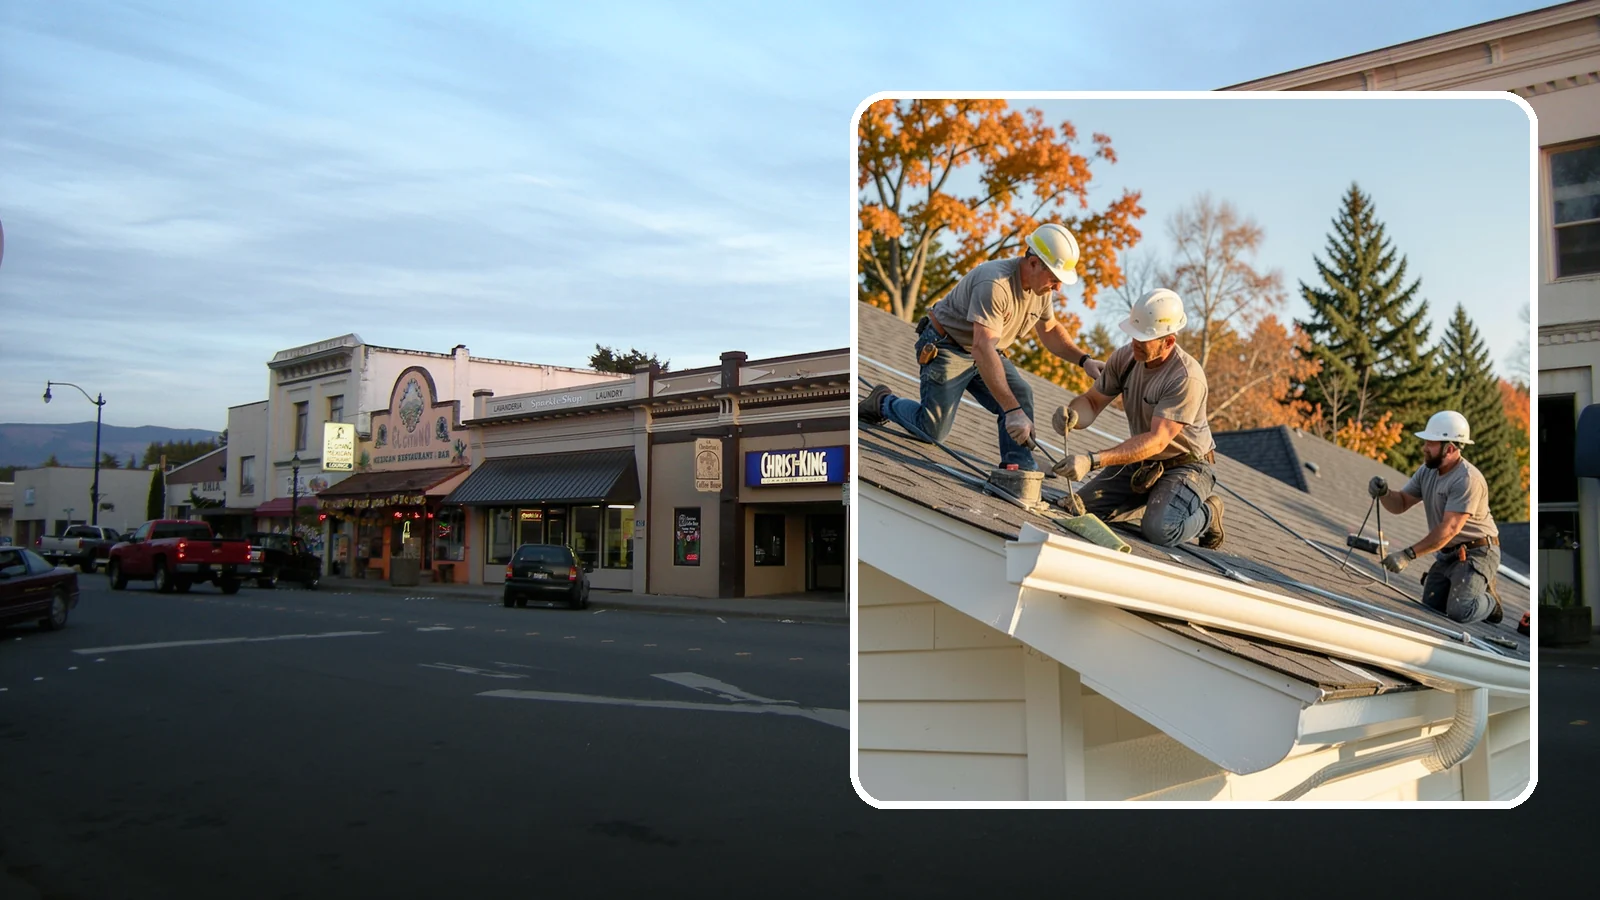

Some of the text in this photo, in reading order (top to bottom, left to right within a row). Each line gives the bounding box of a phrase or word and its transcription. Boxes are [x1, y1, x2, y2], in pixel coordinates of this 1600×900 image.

[596, 389, 623, 399] LAUNDRY
[493, 402, 522, 412] LAVANDERIA
[531, 395, 582, 408] Sparkle Shop
[374, 454, 396, 463] MEXICAN
[397, 452, 433, 462] RESTAURANT
[438, 450, 450, 459] BAR
[761, 450, 827, 477] CHRIST KING
